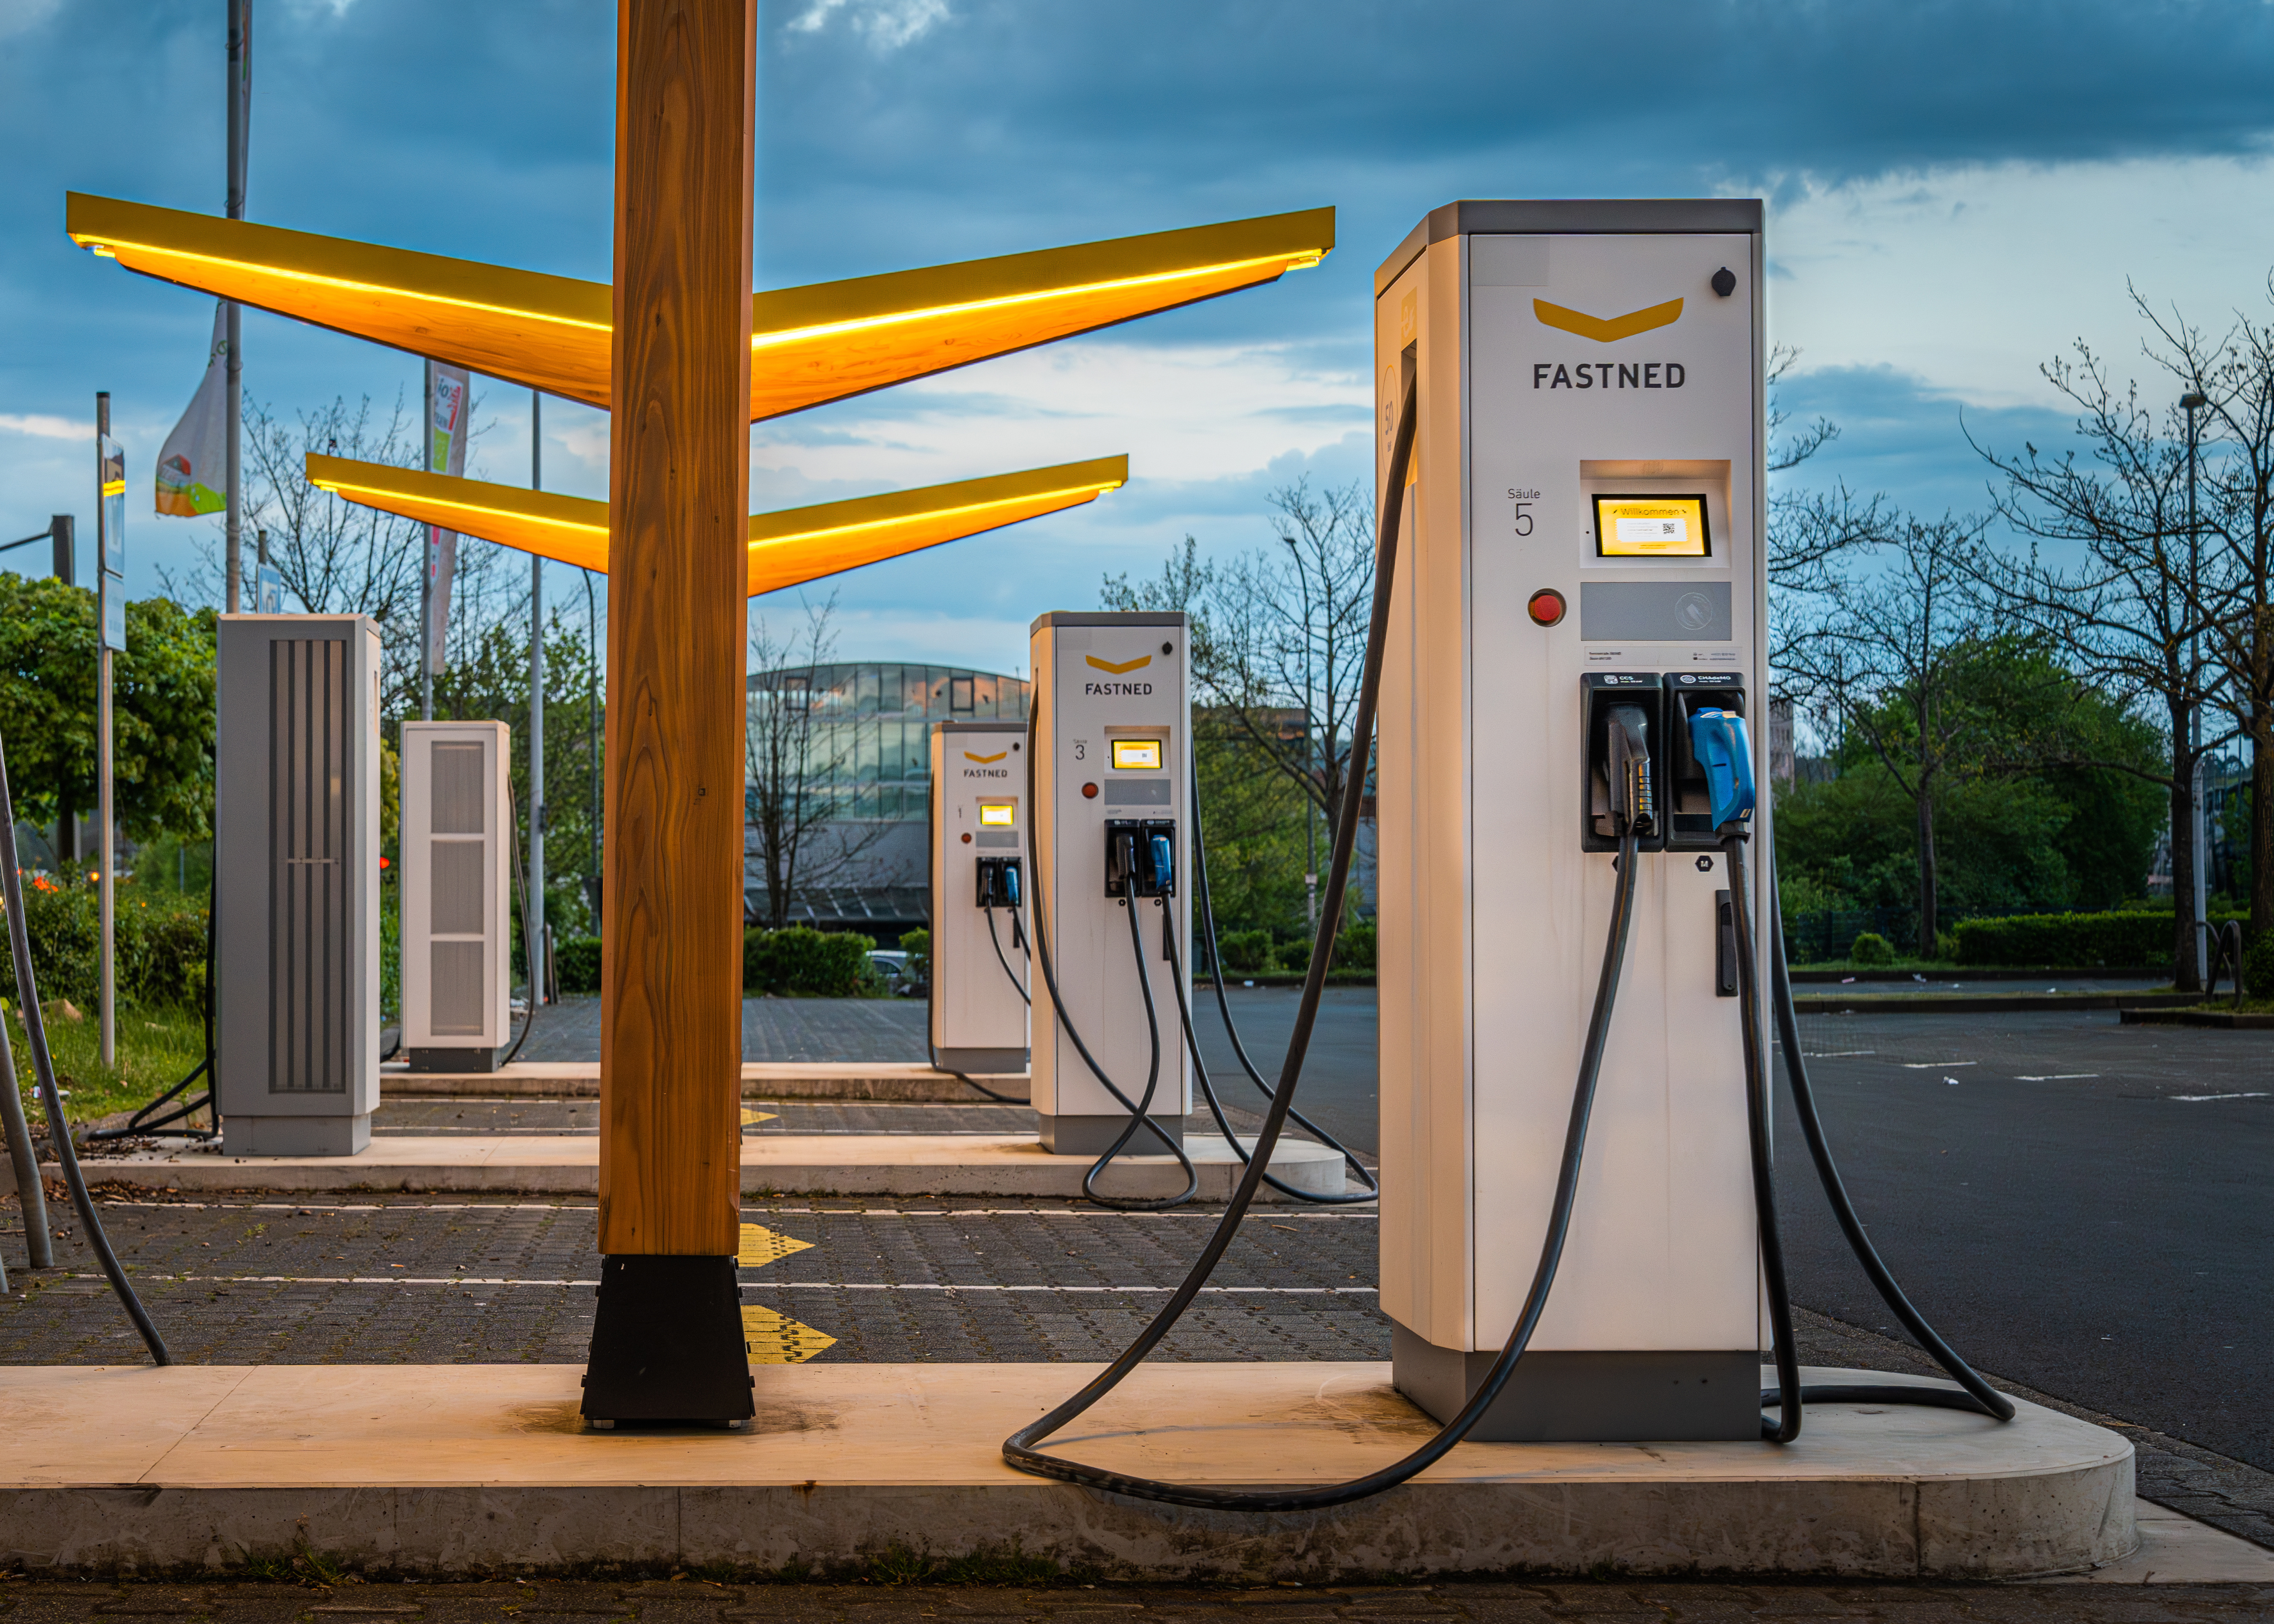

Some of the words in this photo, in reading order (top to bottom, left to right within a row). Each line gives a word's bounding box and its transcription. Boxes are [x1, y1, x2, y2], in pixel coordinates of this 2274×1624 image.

[1533, 363, 1685, 389] FASTNED
[1385, 400, 1393, 435] 50
[1508, 488, 1541, 499] Säule
[1515, 503, 1533, 537] 5
[1085, 683, 1152, 695] FASTNED
[1075, 744, 1085, 760] 3
[963, 769, 1007, 778] FASTNED
